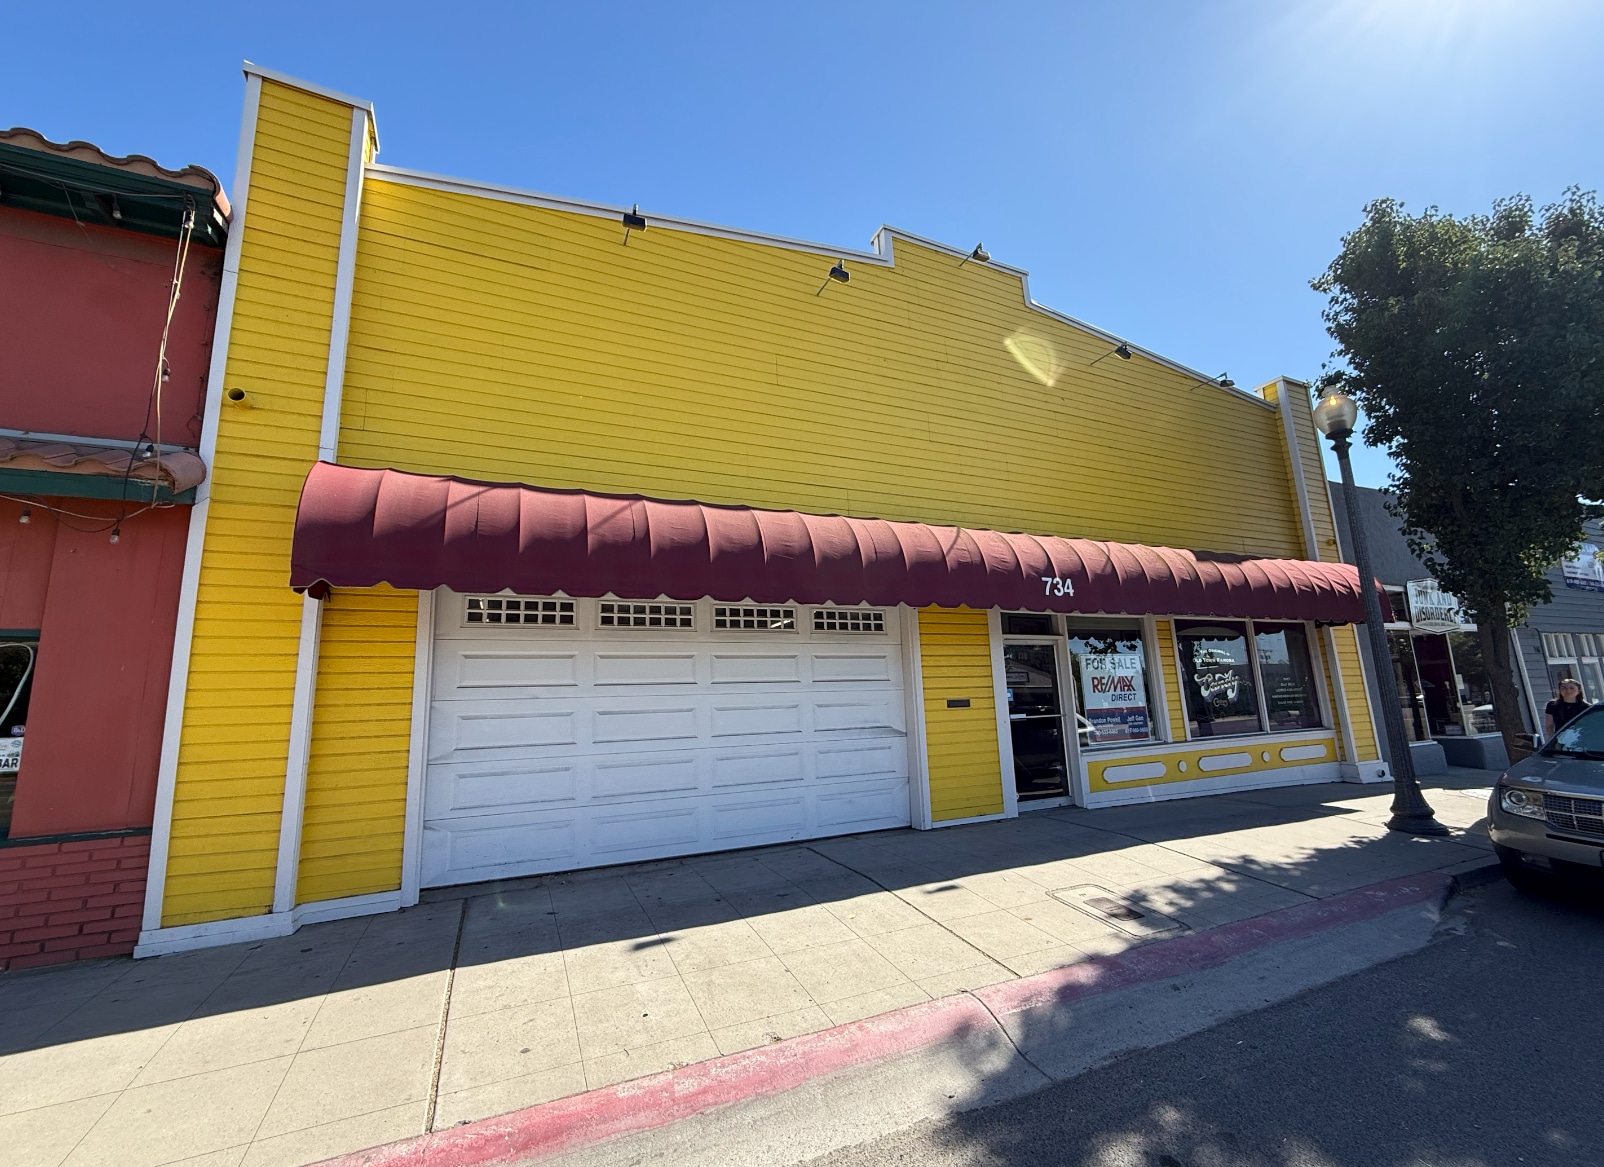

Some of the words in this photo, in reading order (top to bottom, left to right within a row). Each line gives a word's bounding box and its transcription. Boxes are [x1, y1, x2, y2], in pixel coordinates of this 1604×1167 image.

[1041, 576, 1074, 597] 734
[1414, 589, 1435, 606] JUNK
[1436, 591, 1452, 606] AND
[1085, 657, 1107, 671] FOR
[1109, 657, 1137, 670] SALE
[1091, 675, 1136, 693] RE/MAX
[1194, 669, 1240, 702] Candy
[1111, 693, 1137, 701] DIRECT
